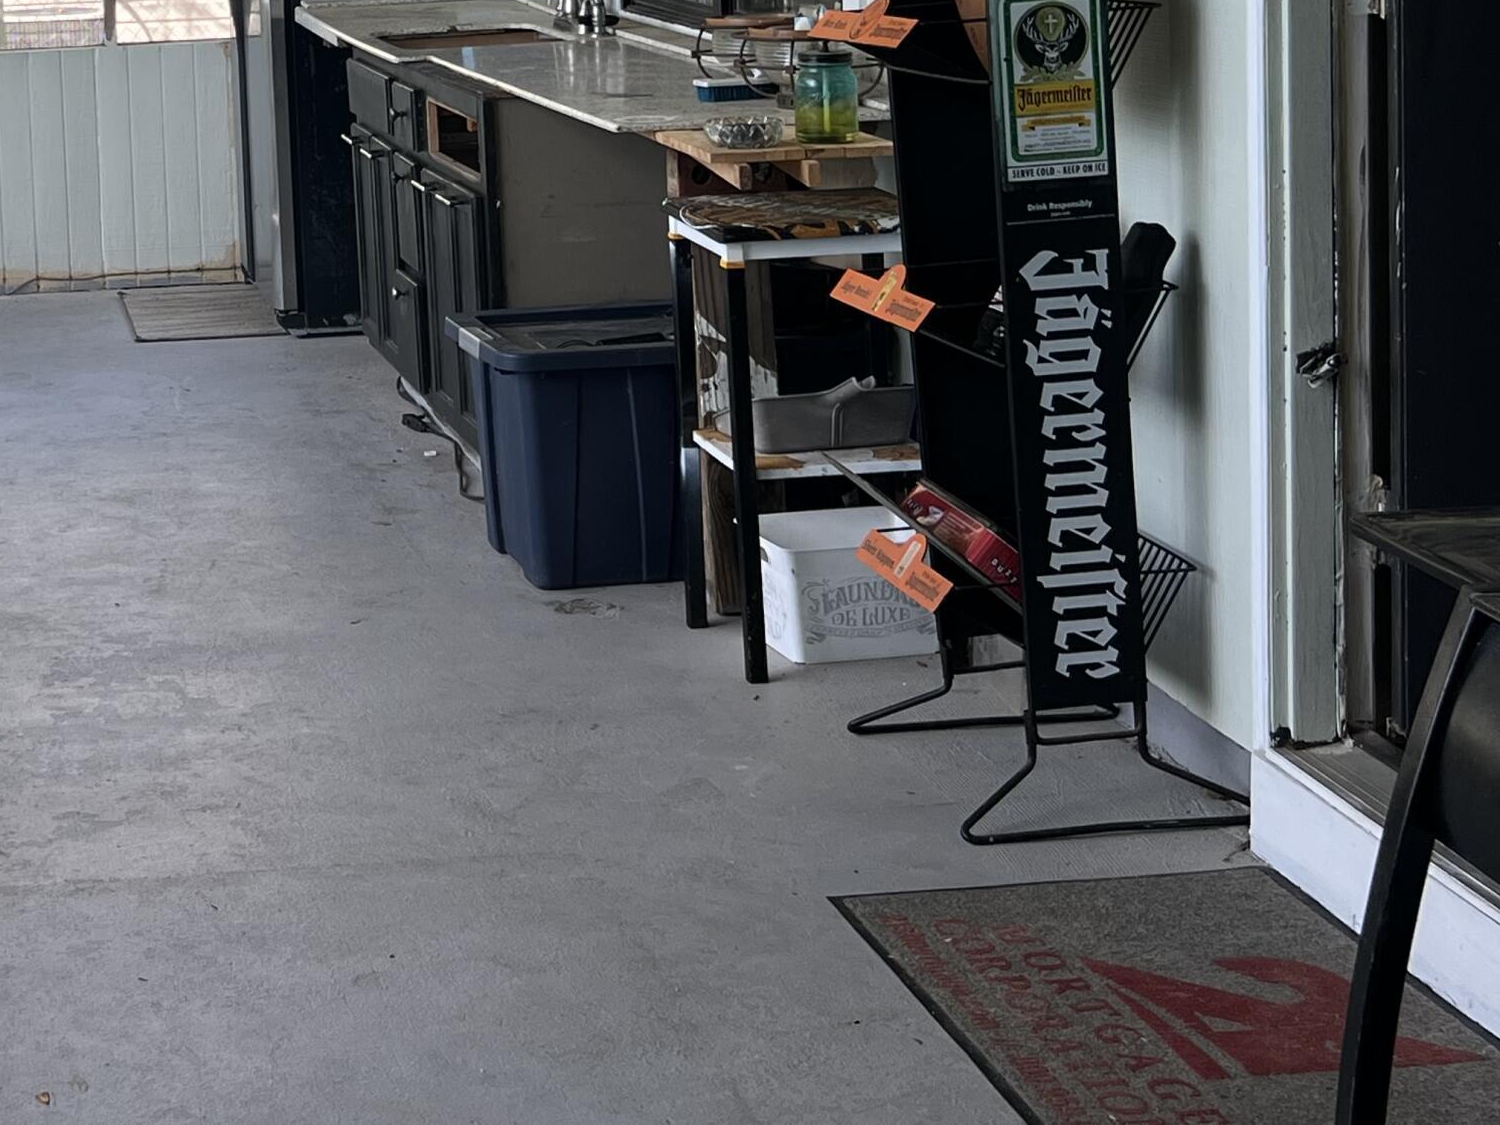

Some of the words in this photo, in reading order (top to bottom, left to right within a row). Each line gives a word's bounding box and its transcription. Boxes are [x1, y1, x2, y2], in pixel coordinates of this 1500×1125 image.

[1016, 84, 1092, 112] Jägermeister
[1012, 168, 1034, 179] SERVE
[1036, 166, 1055, 177] COLD
[1062, 164, 1080, 175] KEEP
[1082, 163, 1093, 172] ON
[1094, 162, 1106, 172] ICE
[1027, 203, 1047, 212] Drink
[1049, 199, 1093, 211] Responsibly
[1018, 248, 1128, 679] Jägermeister
[862, 606, 911, 626] LUXE
